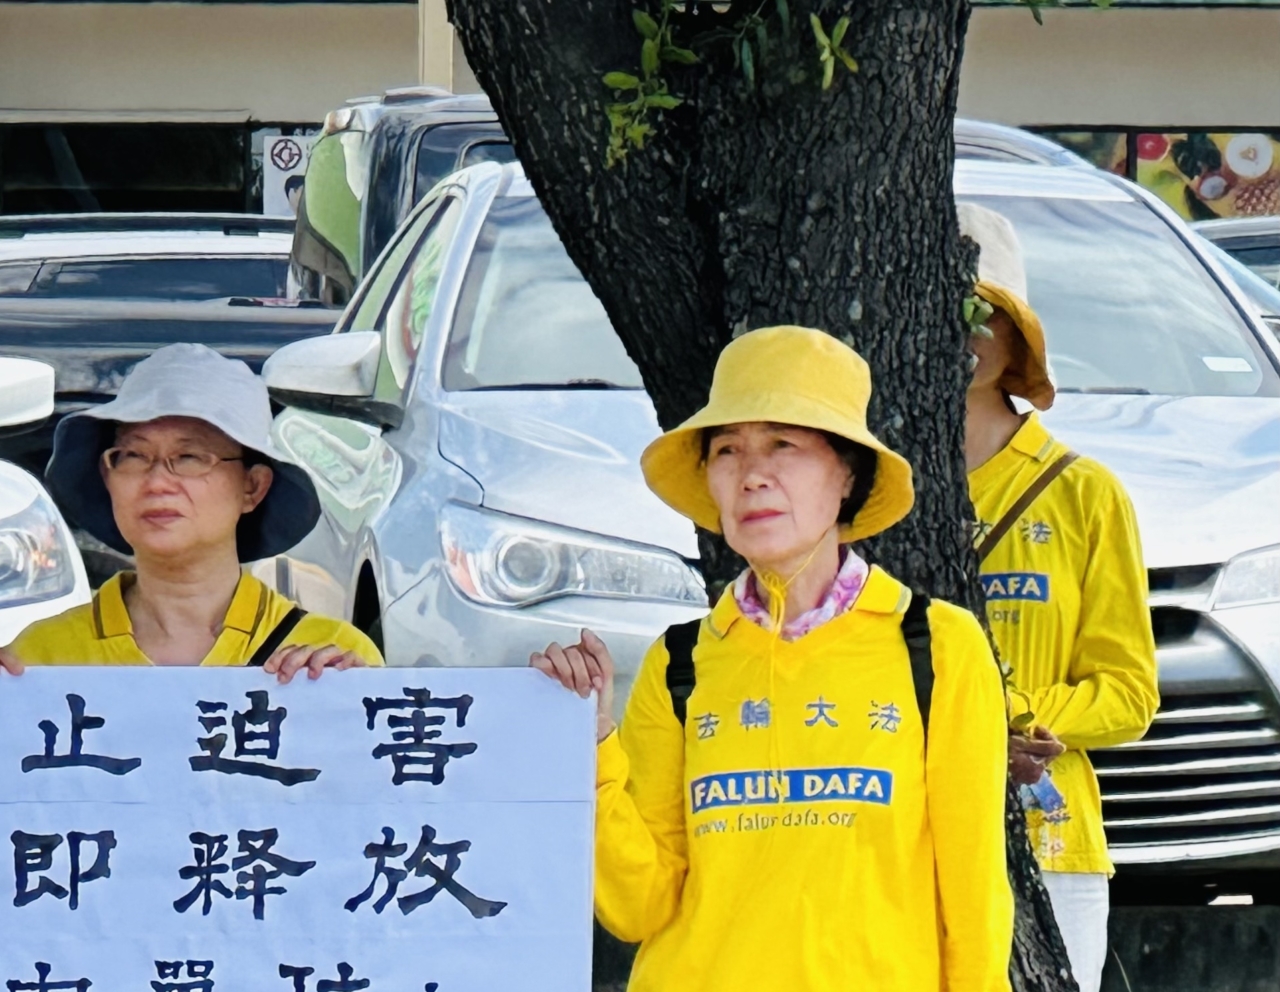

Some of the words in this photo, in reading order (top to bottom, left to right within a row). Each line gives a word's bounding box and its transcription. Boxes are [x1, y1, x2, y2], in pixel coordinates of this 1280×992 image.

[982, 576, 1041, 598] AFA
[694, 775, 790, 808] FALUN
[803, 773, 884, 797] DAFA
